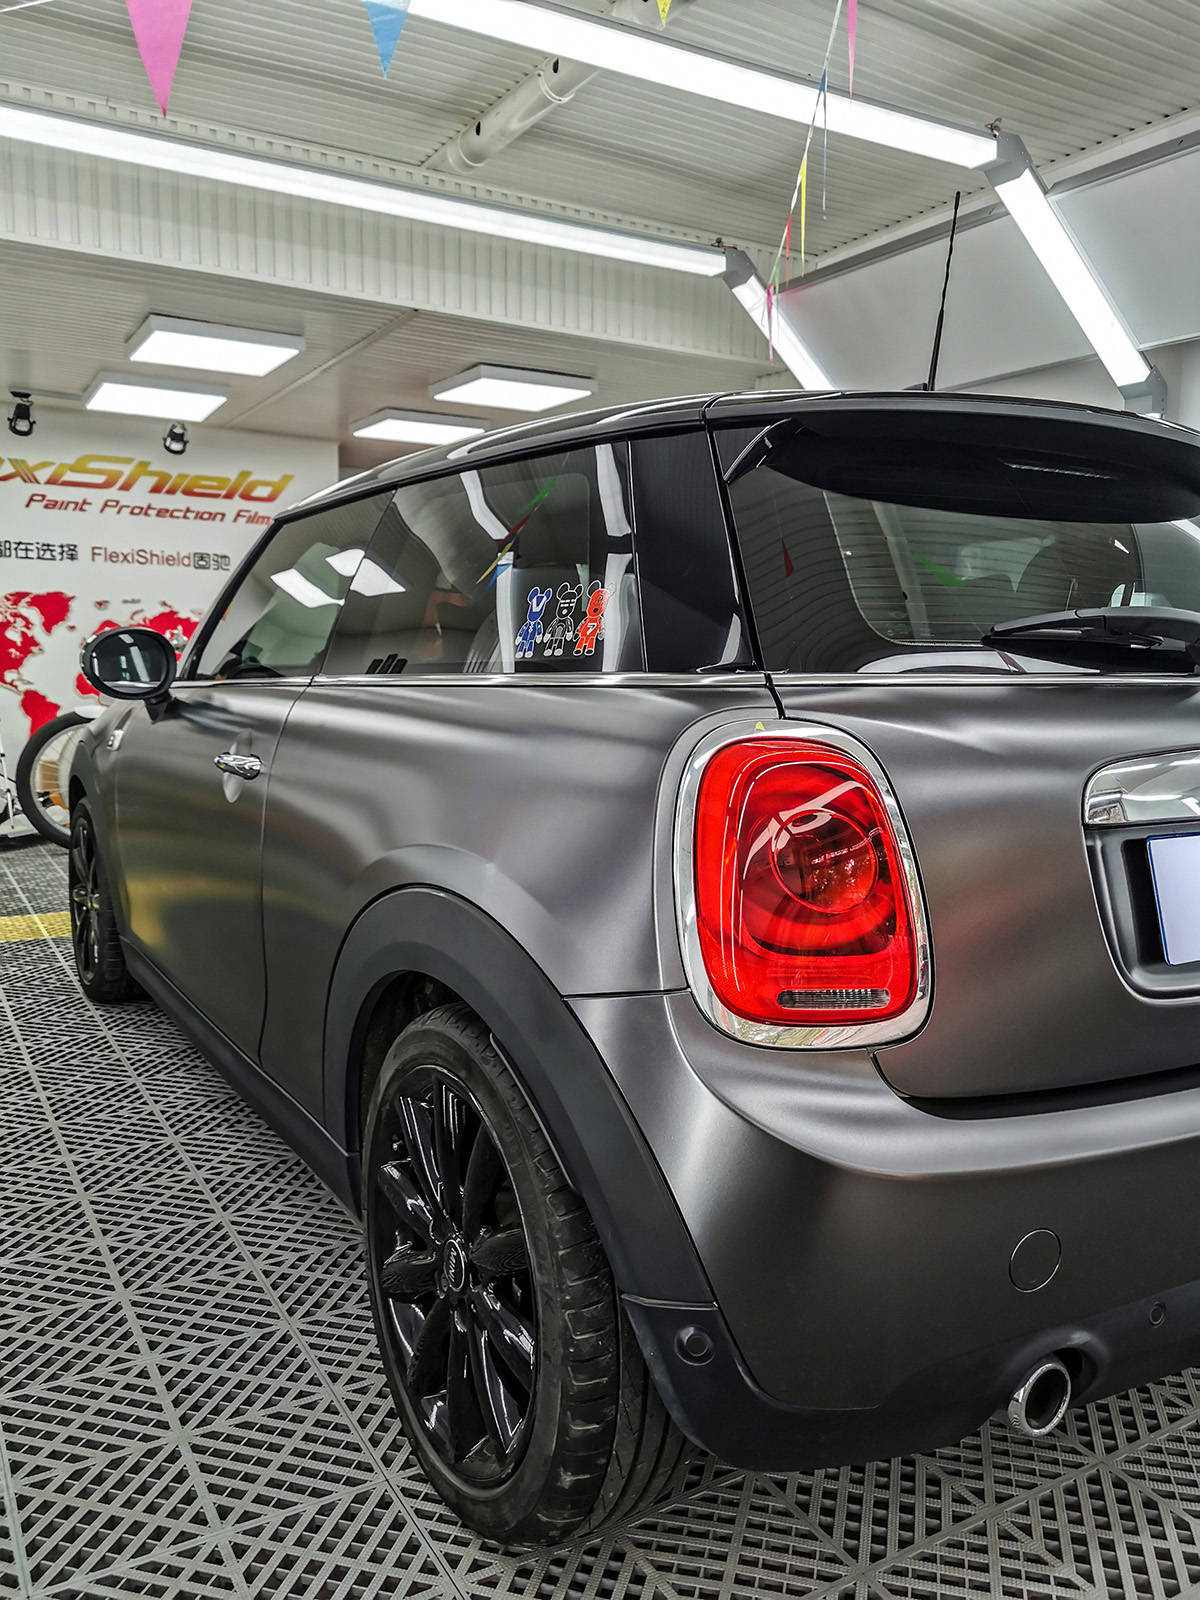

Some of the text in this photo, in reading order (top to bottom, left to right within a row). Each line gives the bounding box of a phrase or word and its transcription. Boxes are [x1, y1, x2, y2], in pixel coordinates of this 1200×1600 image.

[0, 454, 294, 503] xiShield
[25, 493, 272, 525] Paint Protection Film
